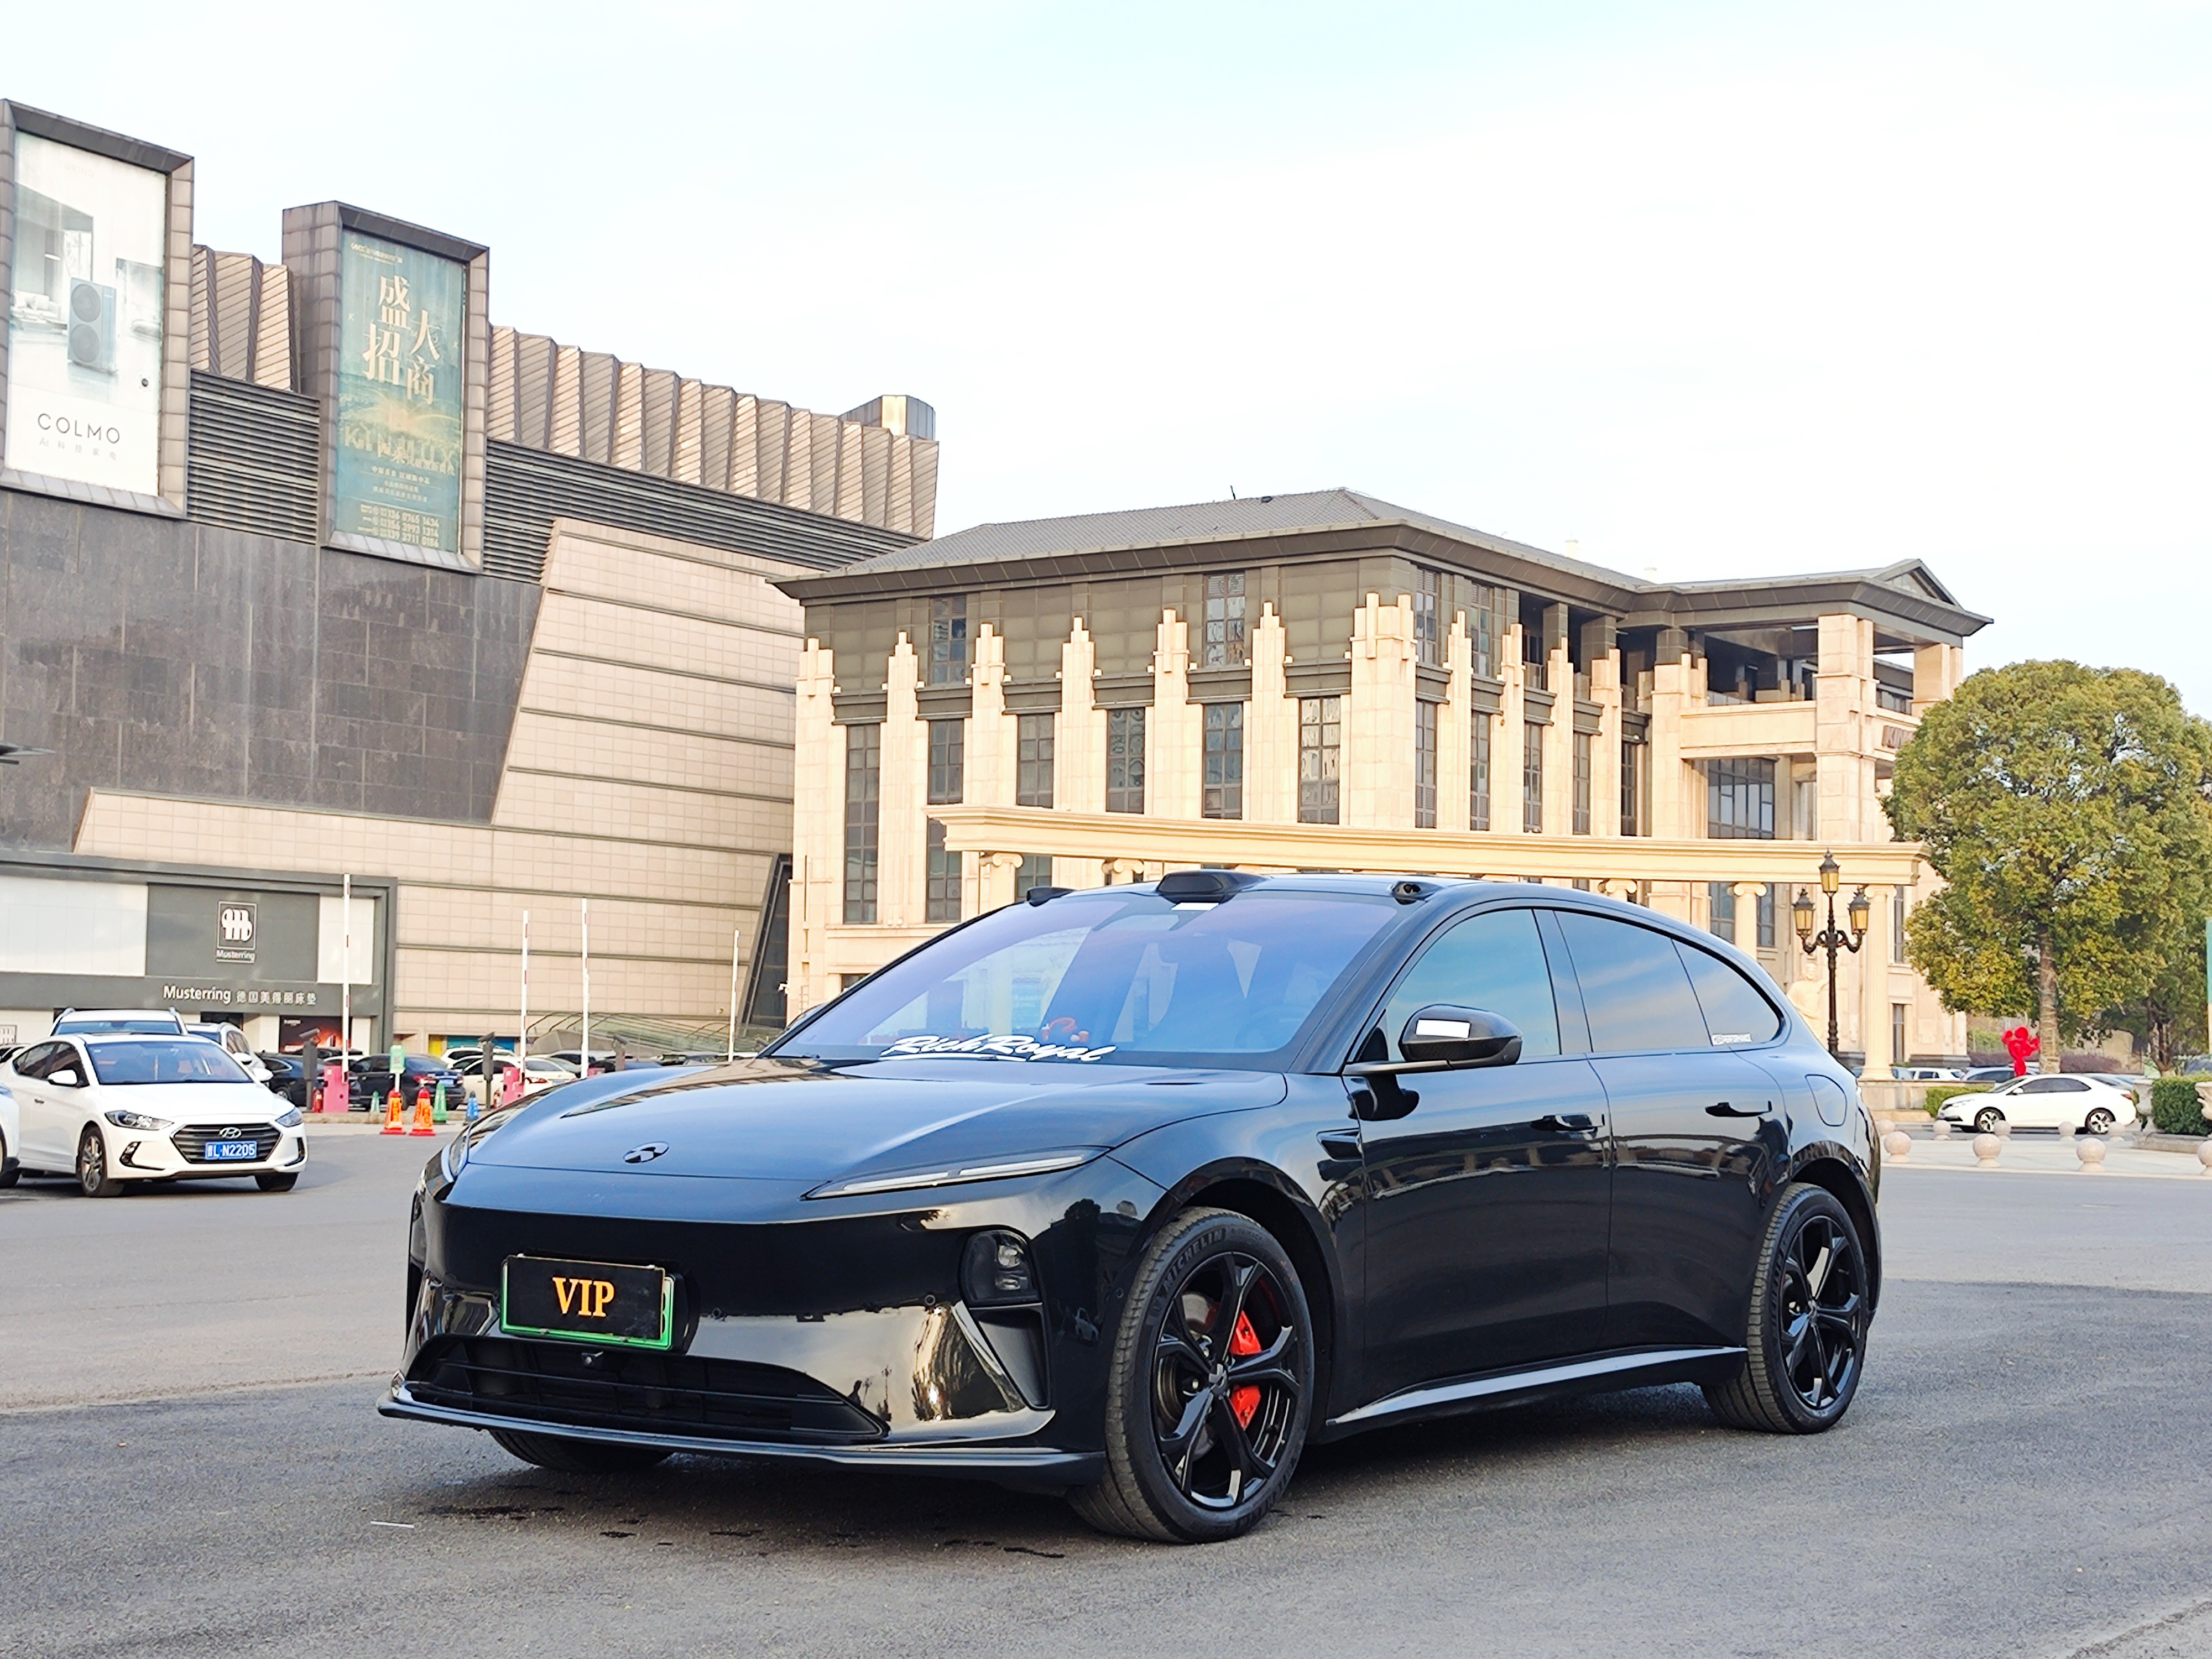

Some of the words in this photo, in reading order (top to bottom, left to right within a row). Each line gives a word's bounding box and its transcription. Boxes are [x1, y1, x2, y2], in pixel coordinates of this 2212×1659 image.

[38, 413, 120, 444] COLMO
[216, 950, 255, 961] Musterring
[163, 985, 232, 1004] Musterring
[236, 990, 317, 1005] 德国美得丽床垫
[552, 1276, 615, 1318] VIP
